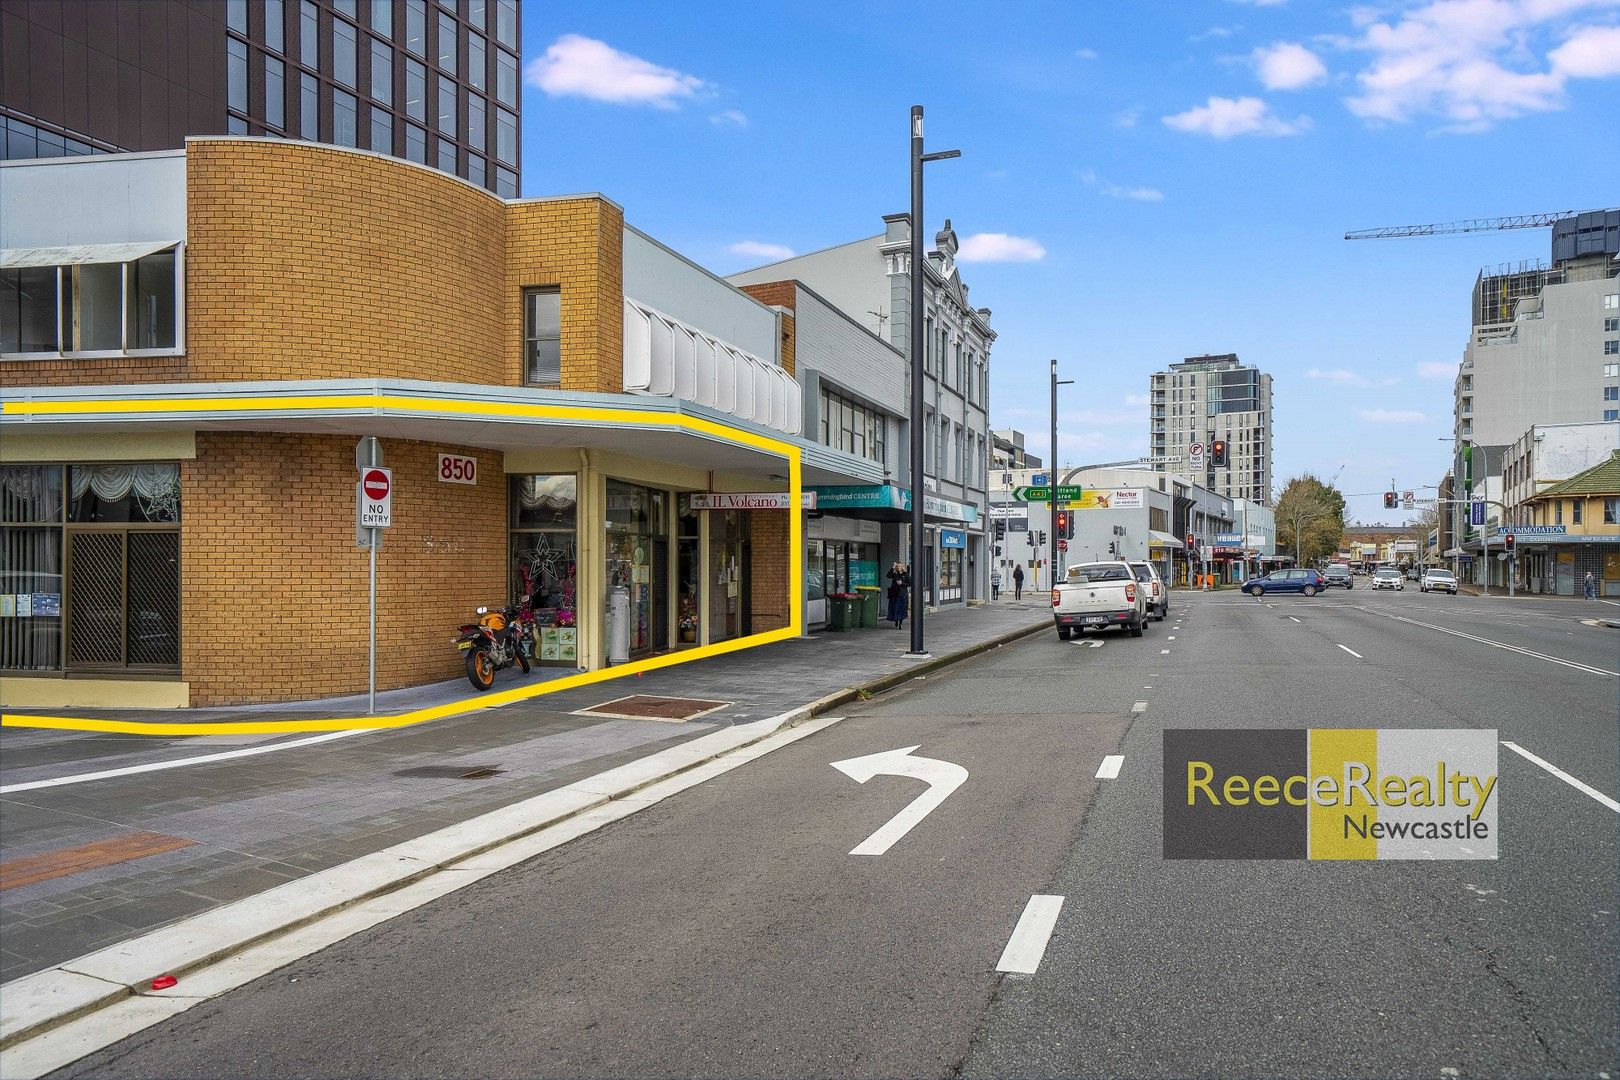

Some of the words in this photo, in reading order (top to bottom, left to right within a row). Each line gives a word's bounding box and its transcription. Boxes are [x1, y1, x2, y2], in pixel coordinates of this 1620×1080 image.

[441, 457, 475, 481] 850
[853, 491, 880, 500] CENTRE
[728, 495, 778, 508] Volcano
[369, 505, 384, 514] NO
[363, 514, 389, 523] ENTRY
[1499, 526, 1565, 534] ACOMMODATION
